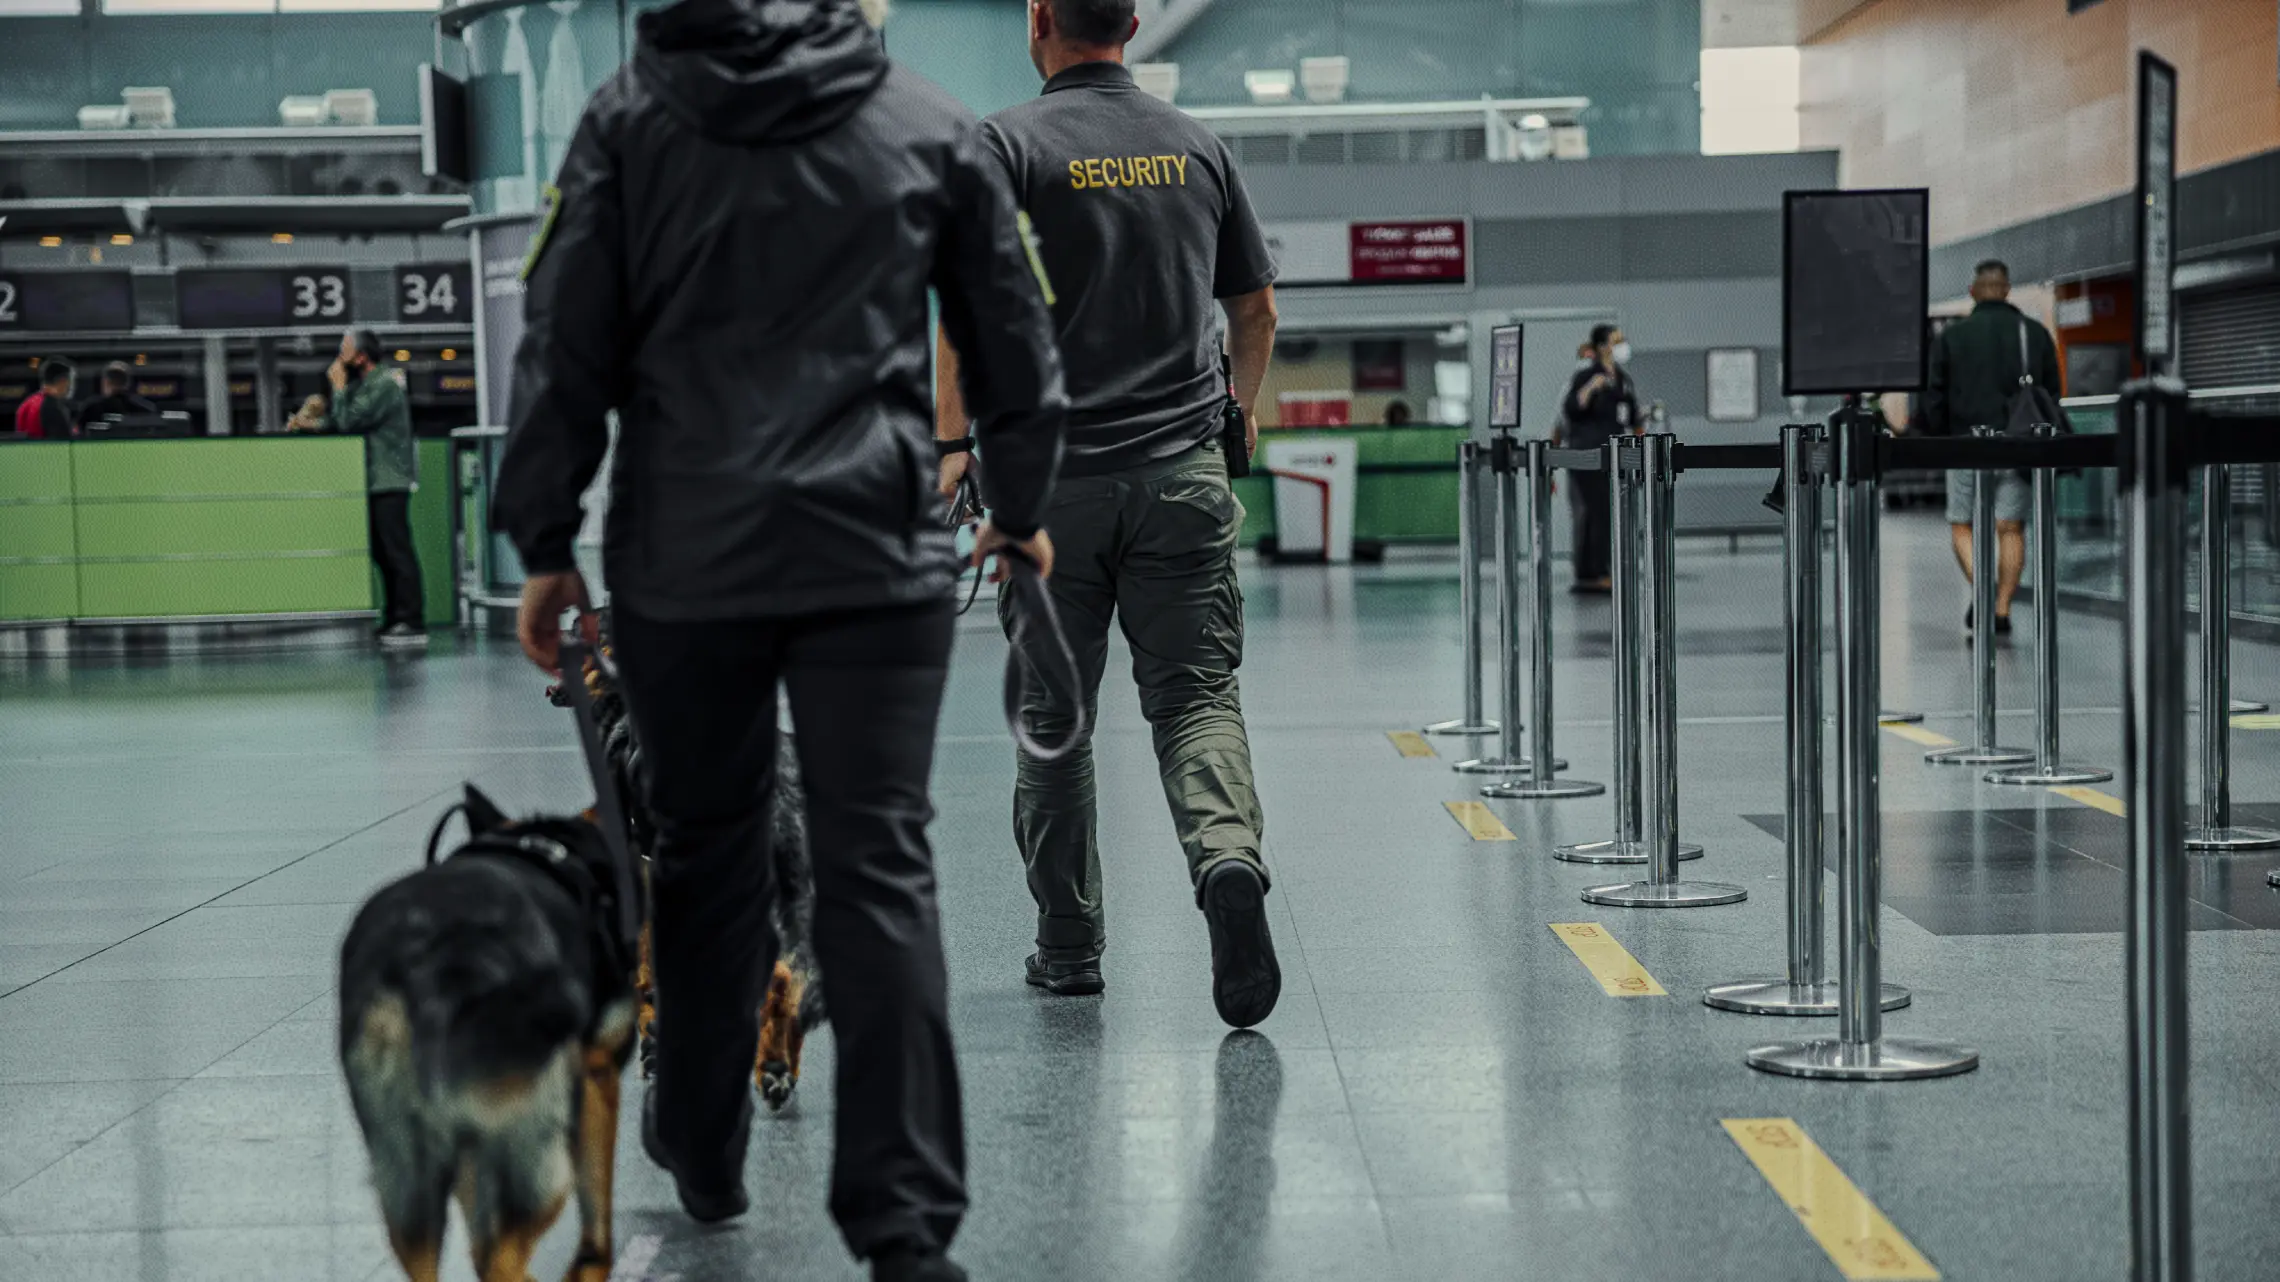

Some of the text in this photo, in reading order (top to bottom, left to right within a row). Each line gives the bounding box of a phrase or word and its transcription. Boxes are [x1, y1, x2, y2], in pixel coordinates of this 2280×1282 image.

[1068, 155, 1188, 190] SECURITY
[292, 275, 346, 317] 33
[402, 273, 457, 316] 34
